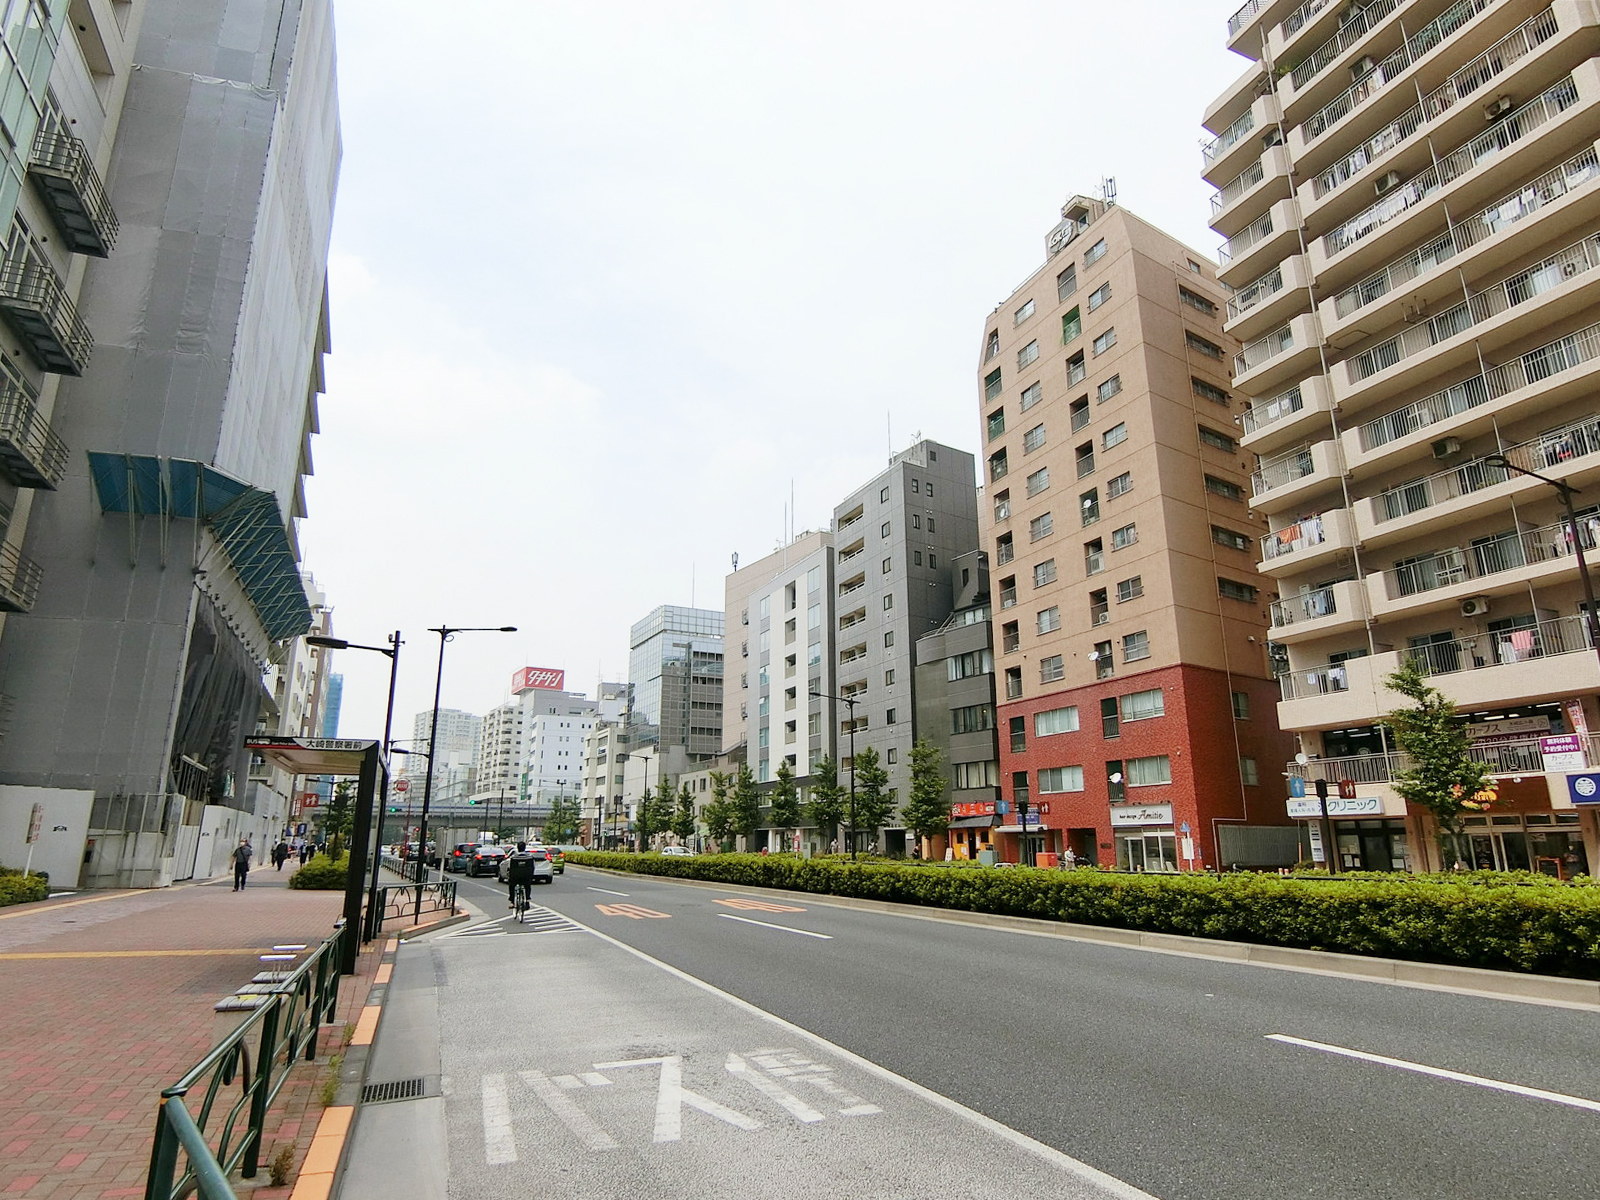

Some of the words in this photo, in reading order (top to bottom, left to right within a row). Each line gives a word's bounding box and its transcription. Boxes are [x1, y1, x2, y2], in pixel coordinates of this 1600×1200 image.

[306, 739, 363, 749] 大崎警察署前
[594, 903, 673, 920] 40
